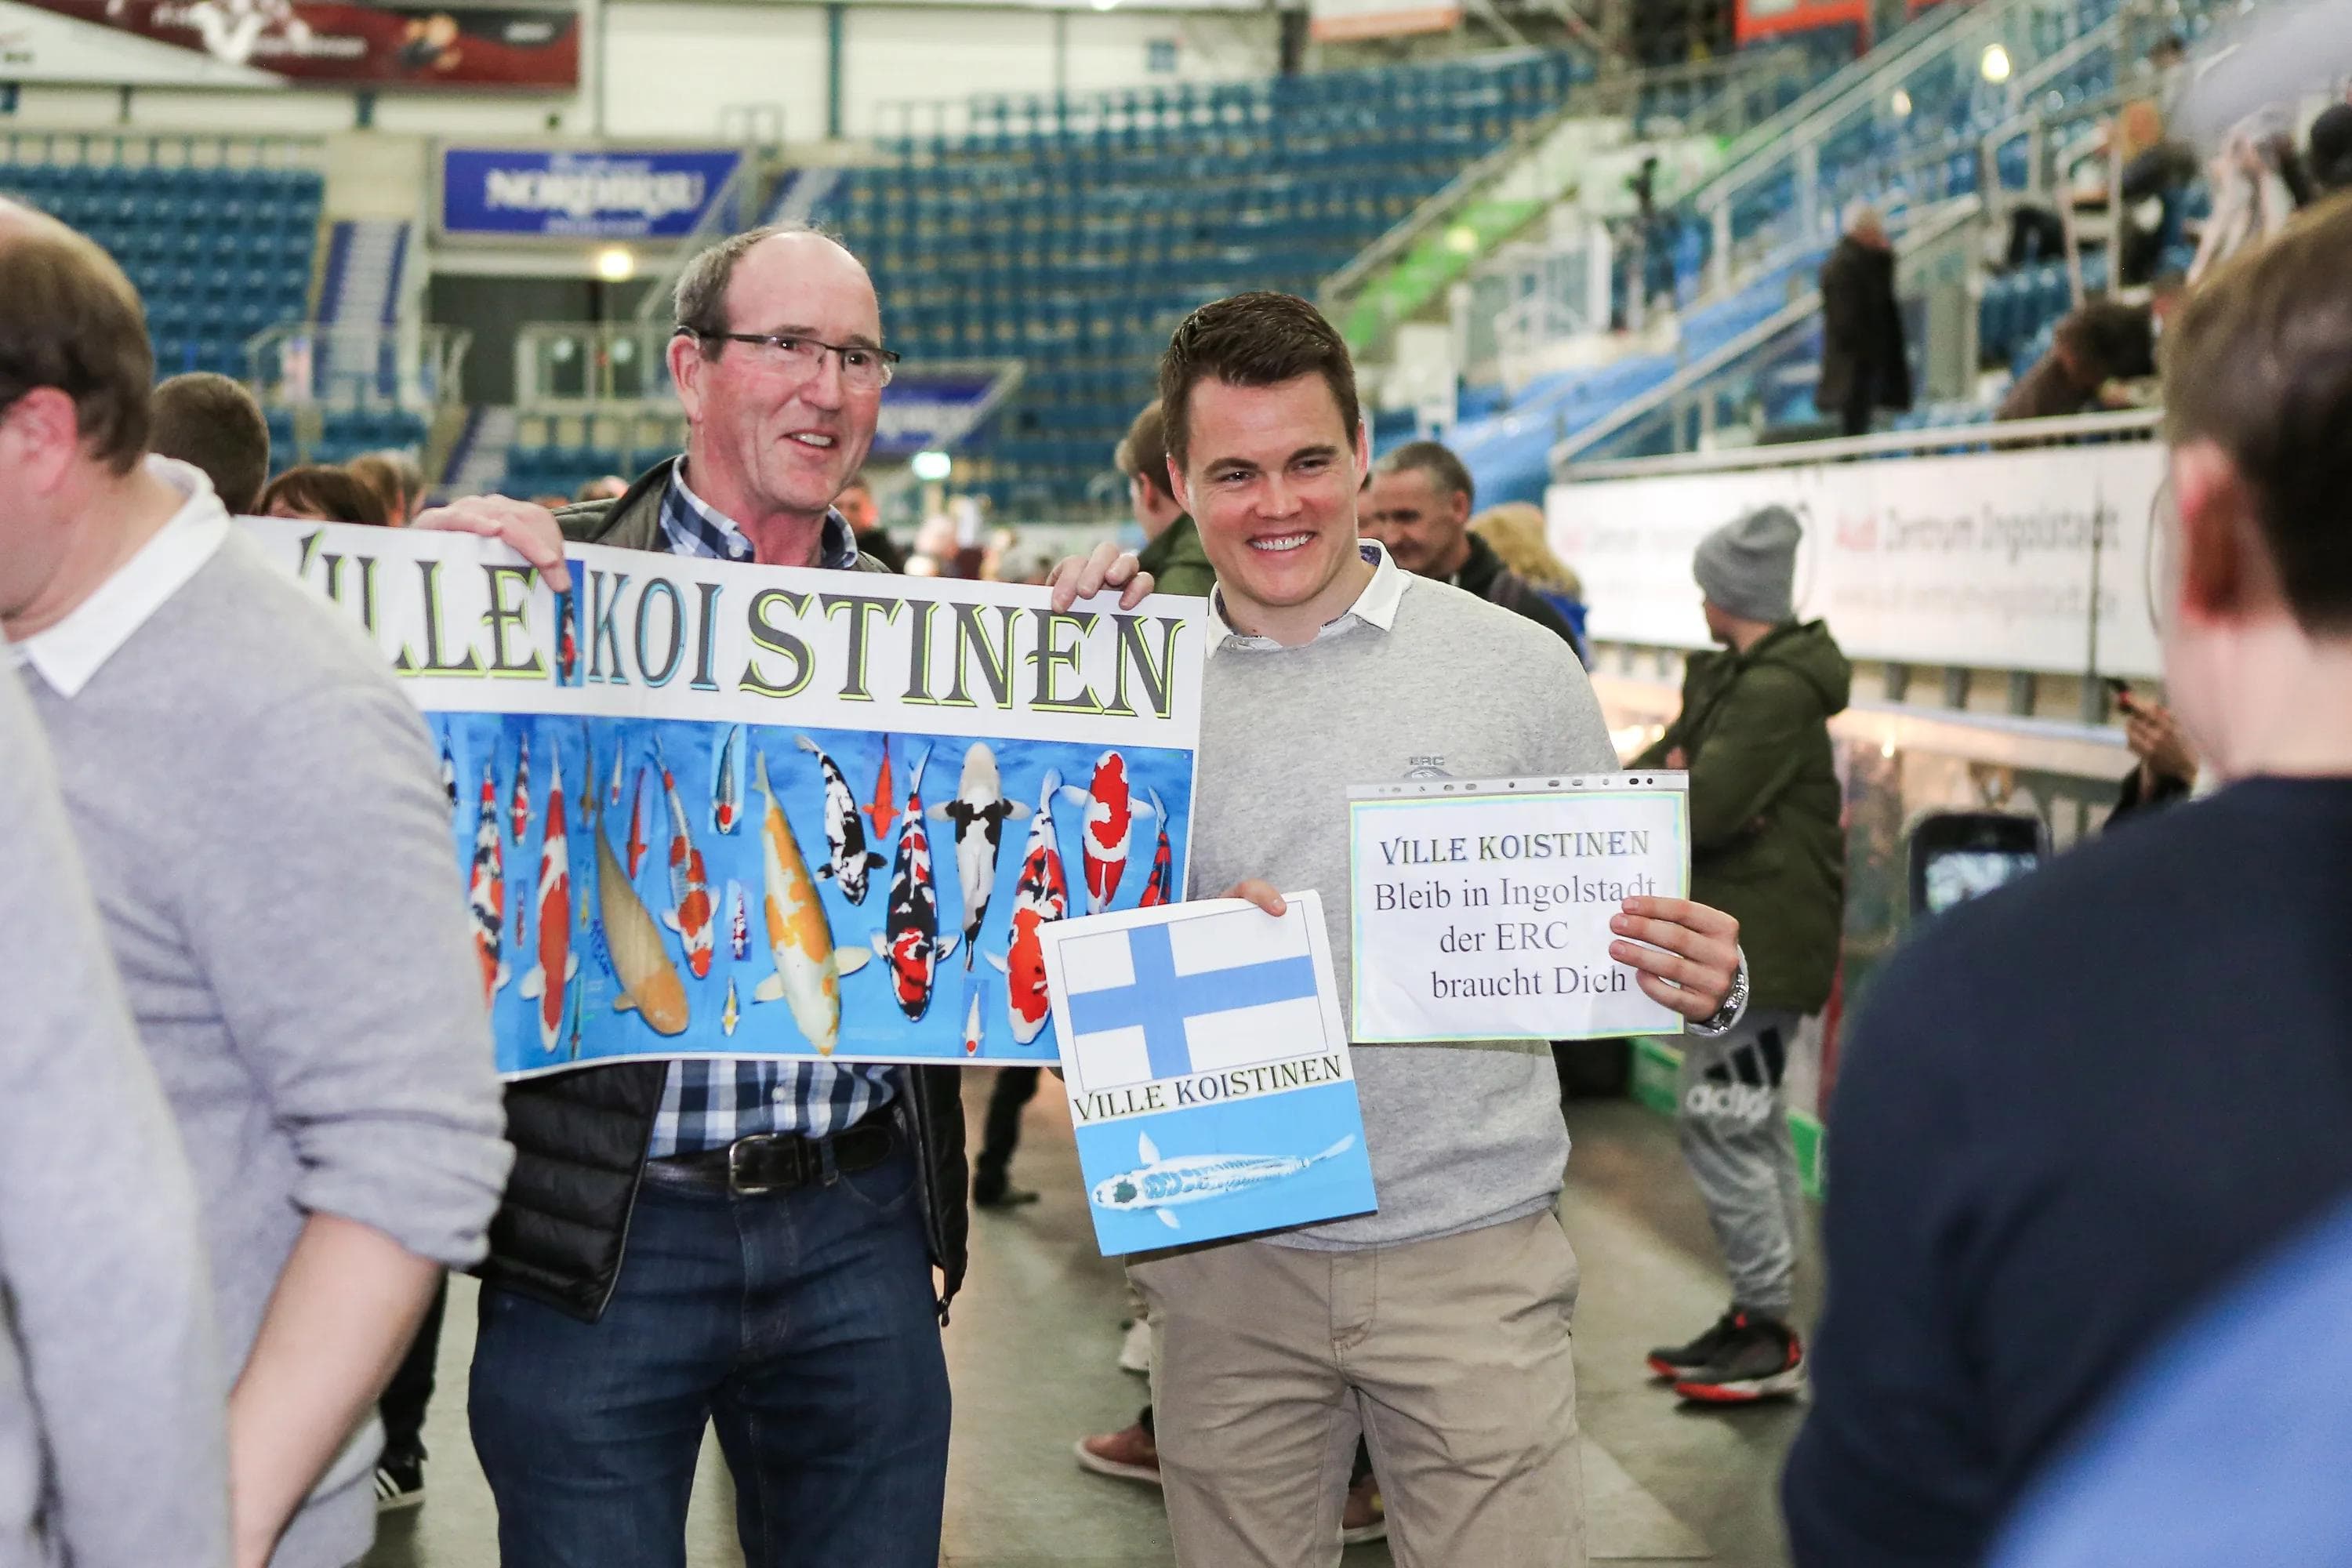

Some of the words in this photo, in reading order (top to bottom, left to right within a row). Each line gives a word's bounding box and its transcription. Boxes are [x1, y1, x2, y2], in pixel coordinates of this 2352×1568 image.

[1409, 756, 1445, 766] ERC
[1379, 836, 1467, 866] VILLE
[1479, 829, 1650, 861] KOISTINEN
[1374, 881, 1451, 911] Bleib
[1462, 878, 1490, 907] in
[1500, 873, 1657, 913] Ingolstadt
[1439, 925, 1486, 953] der
[1495, 920, 1569, 952] ERC
[1431, 967, 1542, 999] braucht
[1553, 964, 1628, 996] Dich
[1073, 1084, 1166, 1121] VILLE
[1175, 1054, 1344, 1106] KOISTINEN
